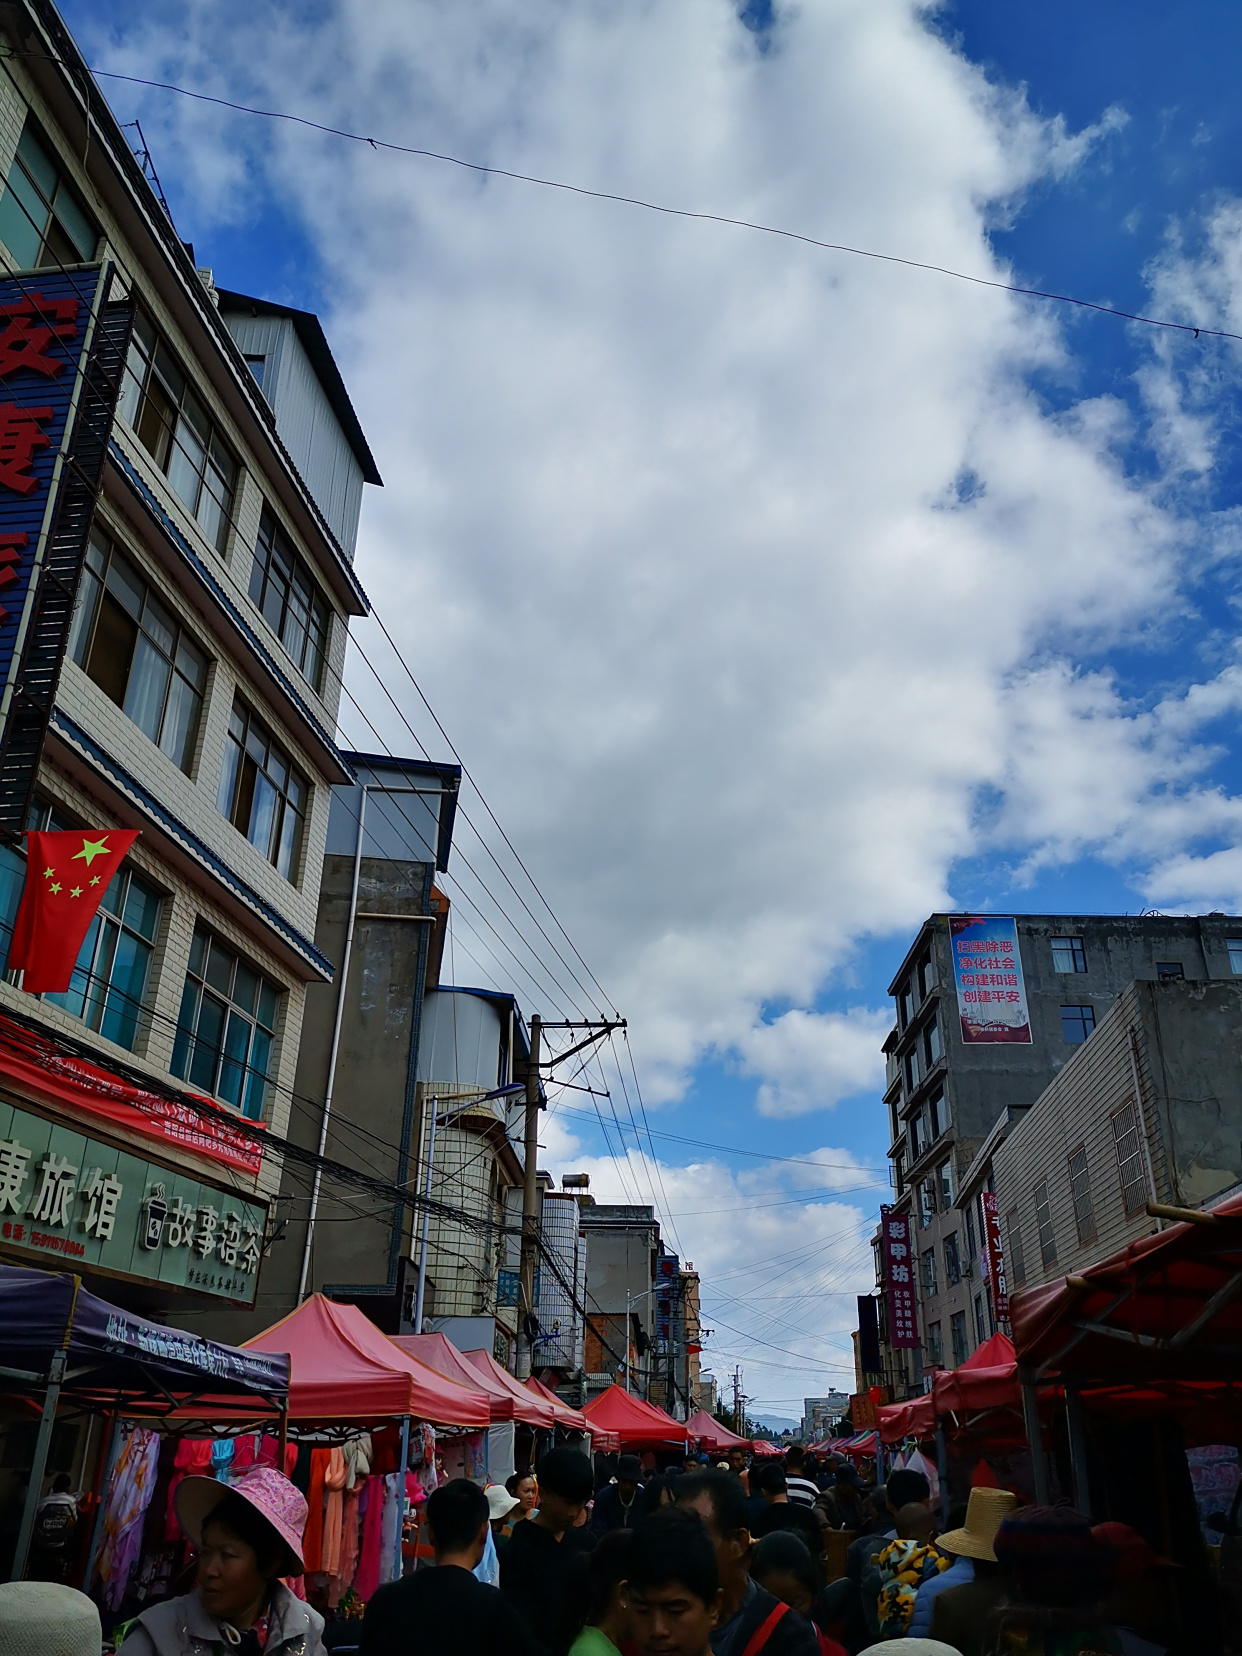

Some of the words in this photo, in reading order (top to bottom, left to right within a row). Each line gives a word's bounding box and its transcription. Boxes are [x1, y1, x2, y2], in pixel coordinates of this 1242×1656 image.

[956, 940, 1014, 953] 扫黑除恶
[958, 956, 1016, 970] 净化社会
[960, 973, 1018, 987] 构建和谐
[963, 990, 1020, 1004] 创建平安
[888, 1221, 909, 1283] 彩甲坊
[894, 1289, 911, 1298] 化妆
